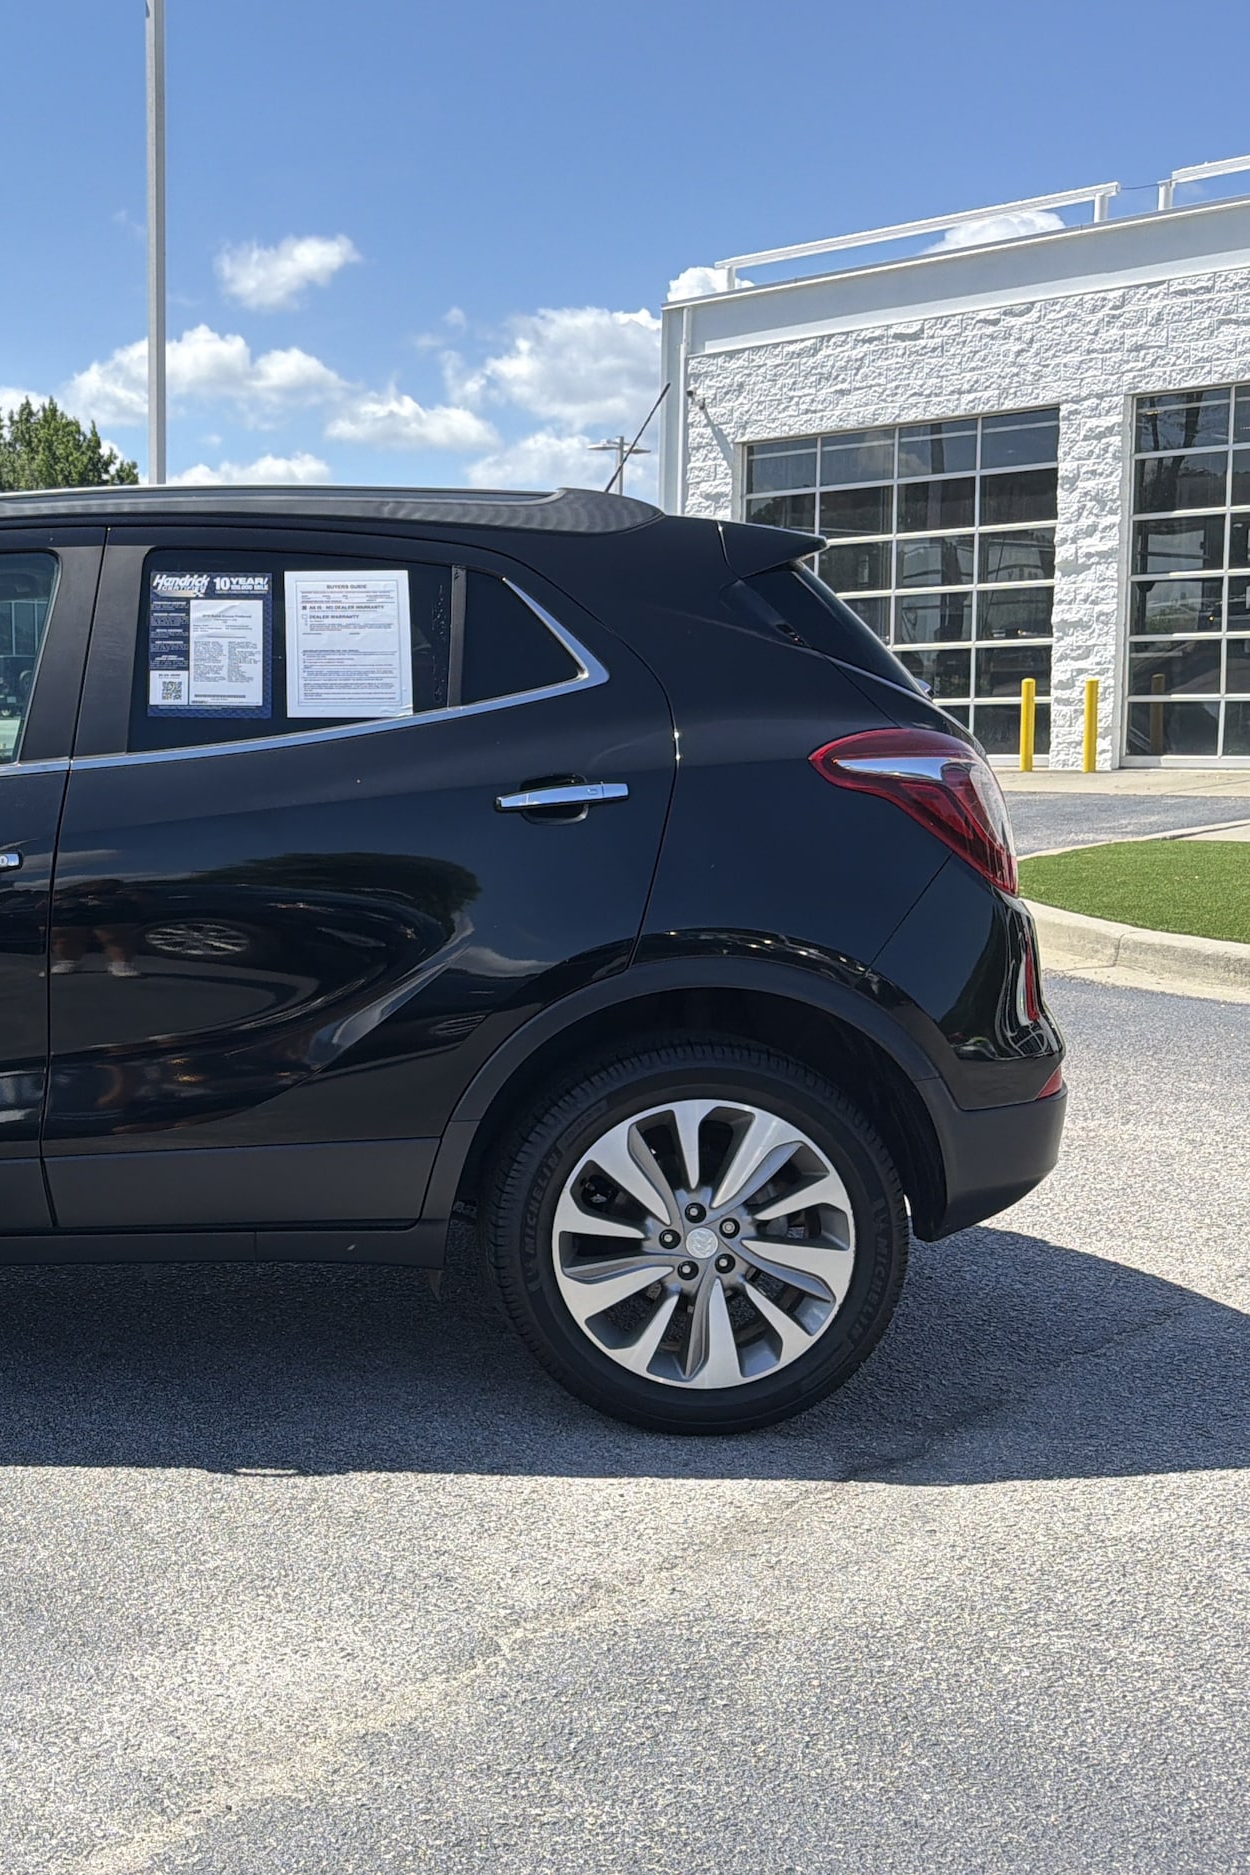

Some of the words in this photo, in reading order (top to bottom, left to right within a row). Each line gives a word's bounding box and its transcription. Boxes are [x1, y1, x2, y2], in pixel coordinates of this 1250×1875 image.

[213, 577, 230, 591] 10
[523, 1146, 564, 1255] MICHELIN
[847, 1236, 889, 1338] MICHELIN
